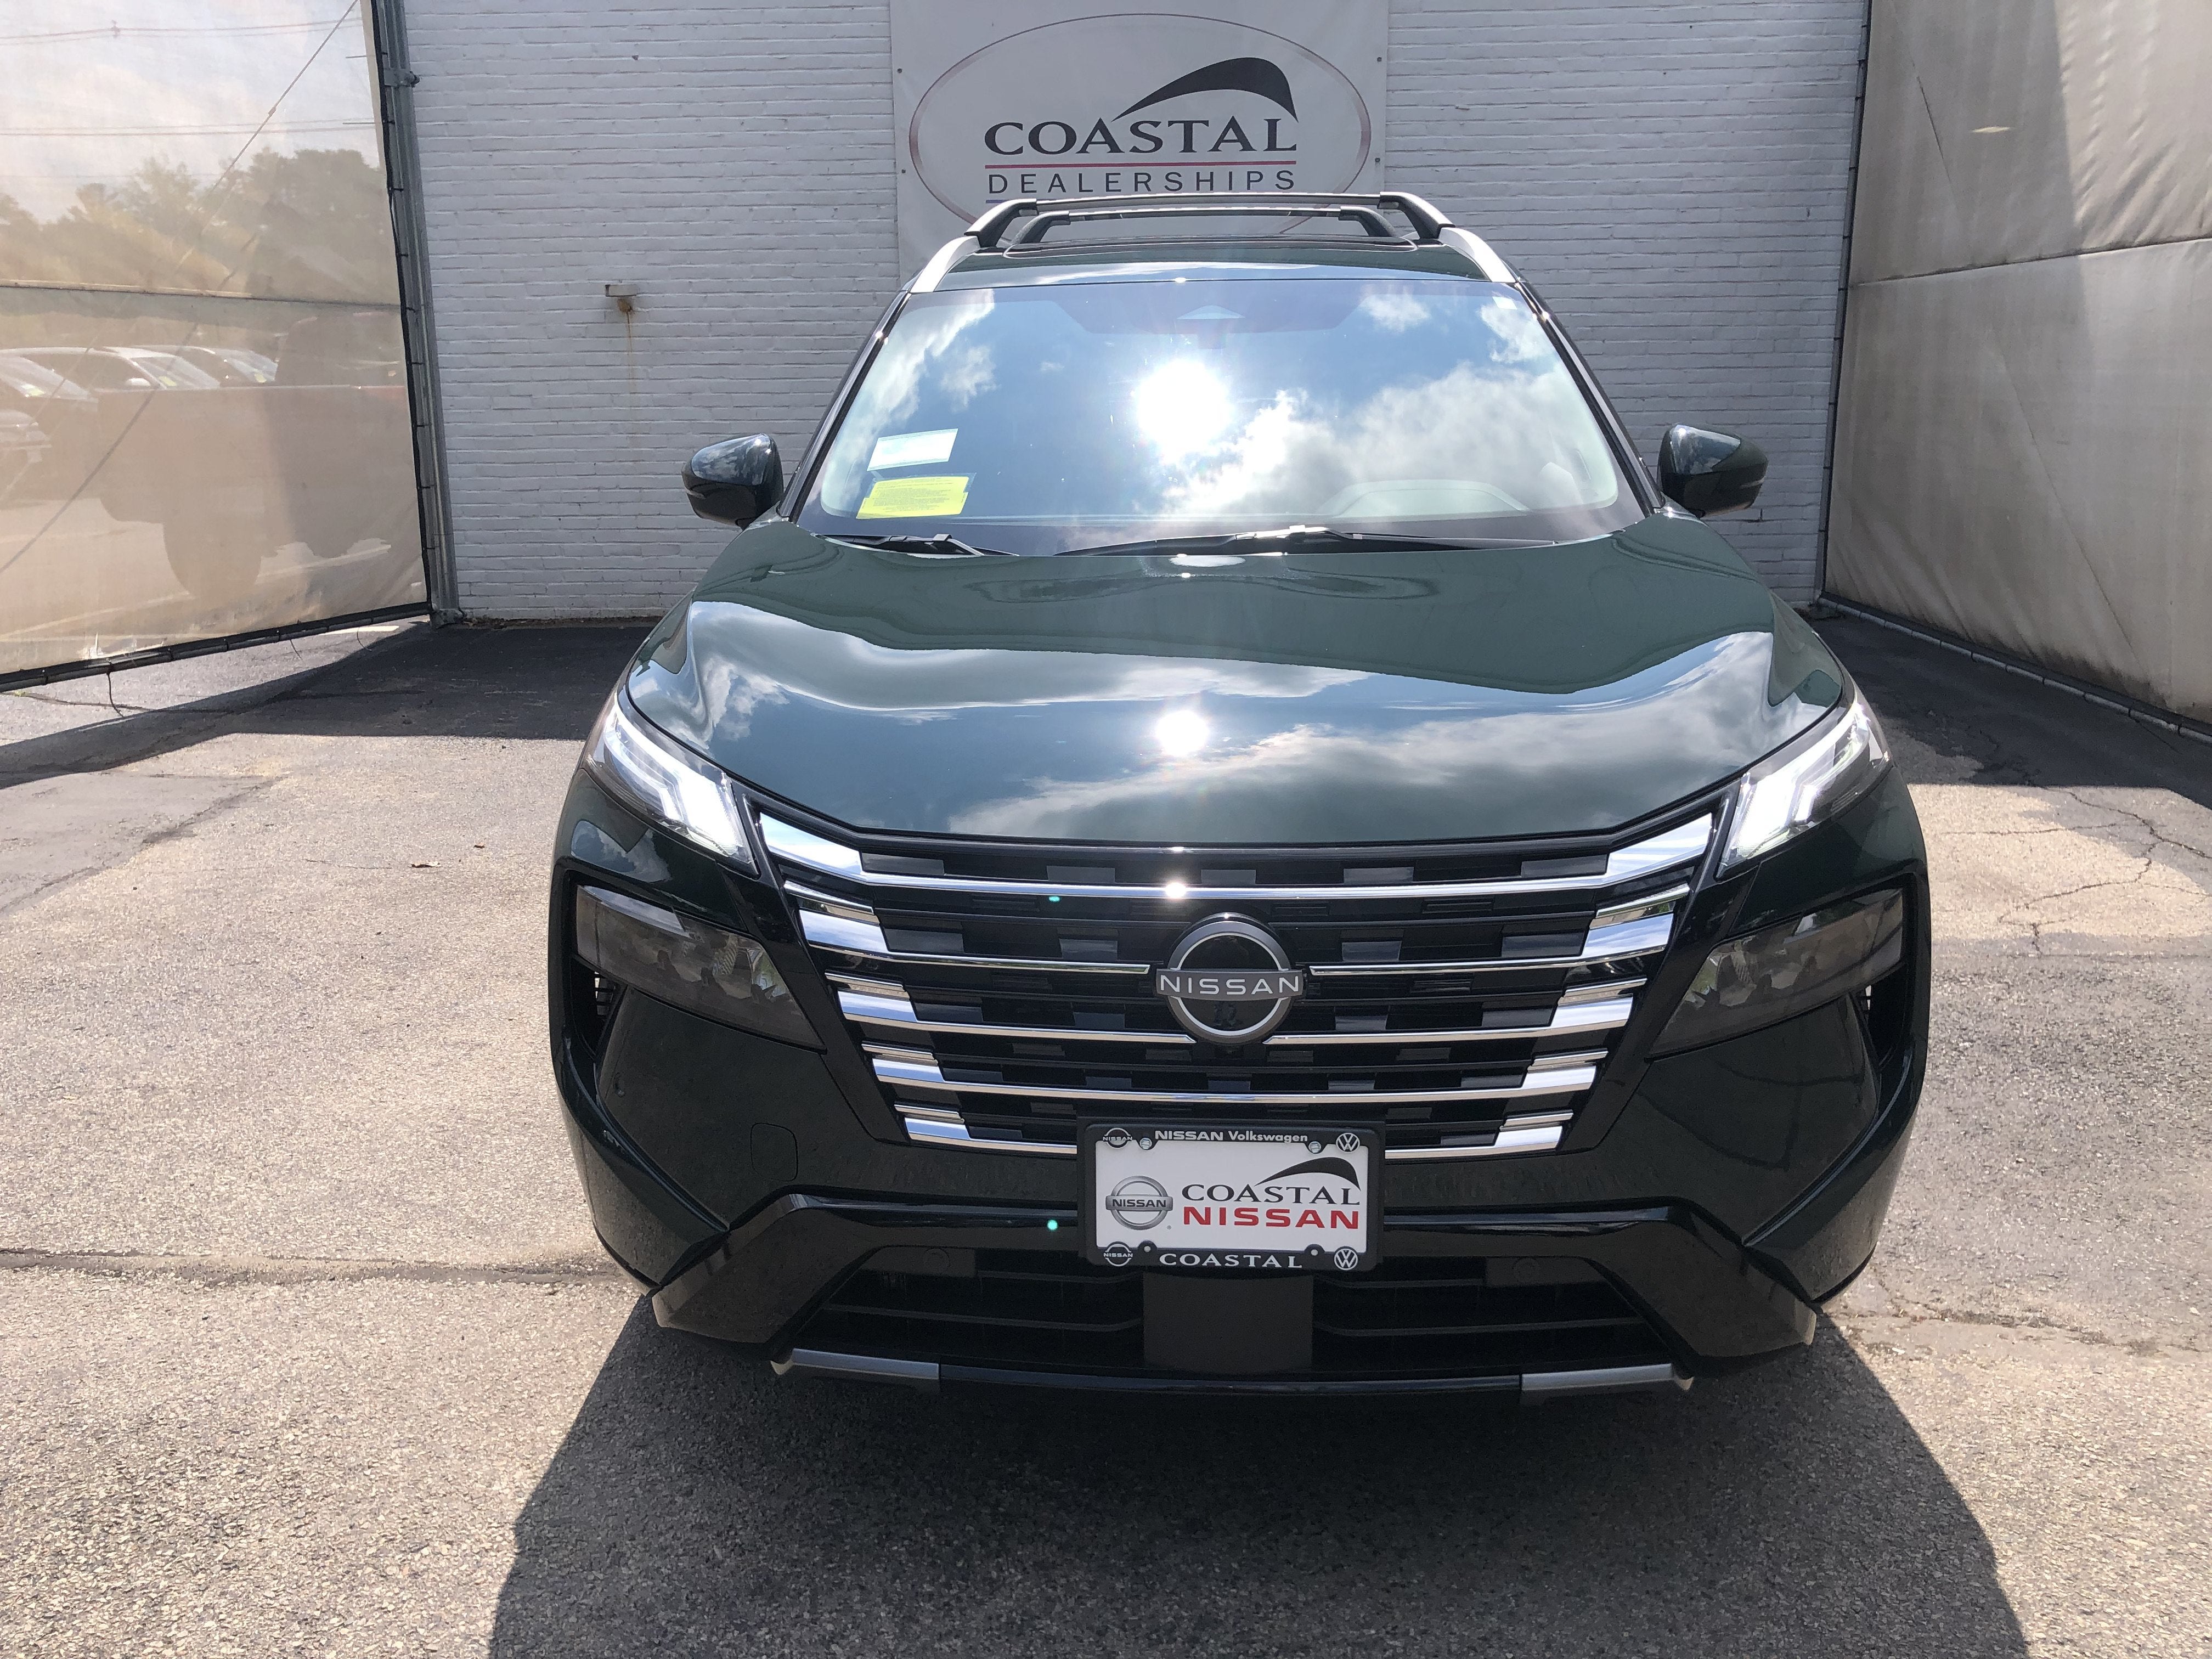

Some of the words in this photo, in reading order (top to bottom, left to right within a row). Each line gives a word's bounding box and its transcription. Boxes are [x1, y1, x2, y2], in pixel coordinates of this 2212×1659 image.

[984, 116, 1297, 155] COASTAL
[989, 170, 1295, 194] DEALERSHIPS
[1160, 975, 1299, 995] NISSAN
[1155, 1130, 1223, 1141] NISSAN
[1228, 1131, 1308, 1143] Volkswagen
[1112, 1199, 1167, 1208] NISSAN
[1181, 1183, 1361, 1206] COASTAL
[1183, 1206, 1359, 1229] NISSAN
[1159, 1253, 1302, 1268] COASTAL
